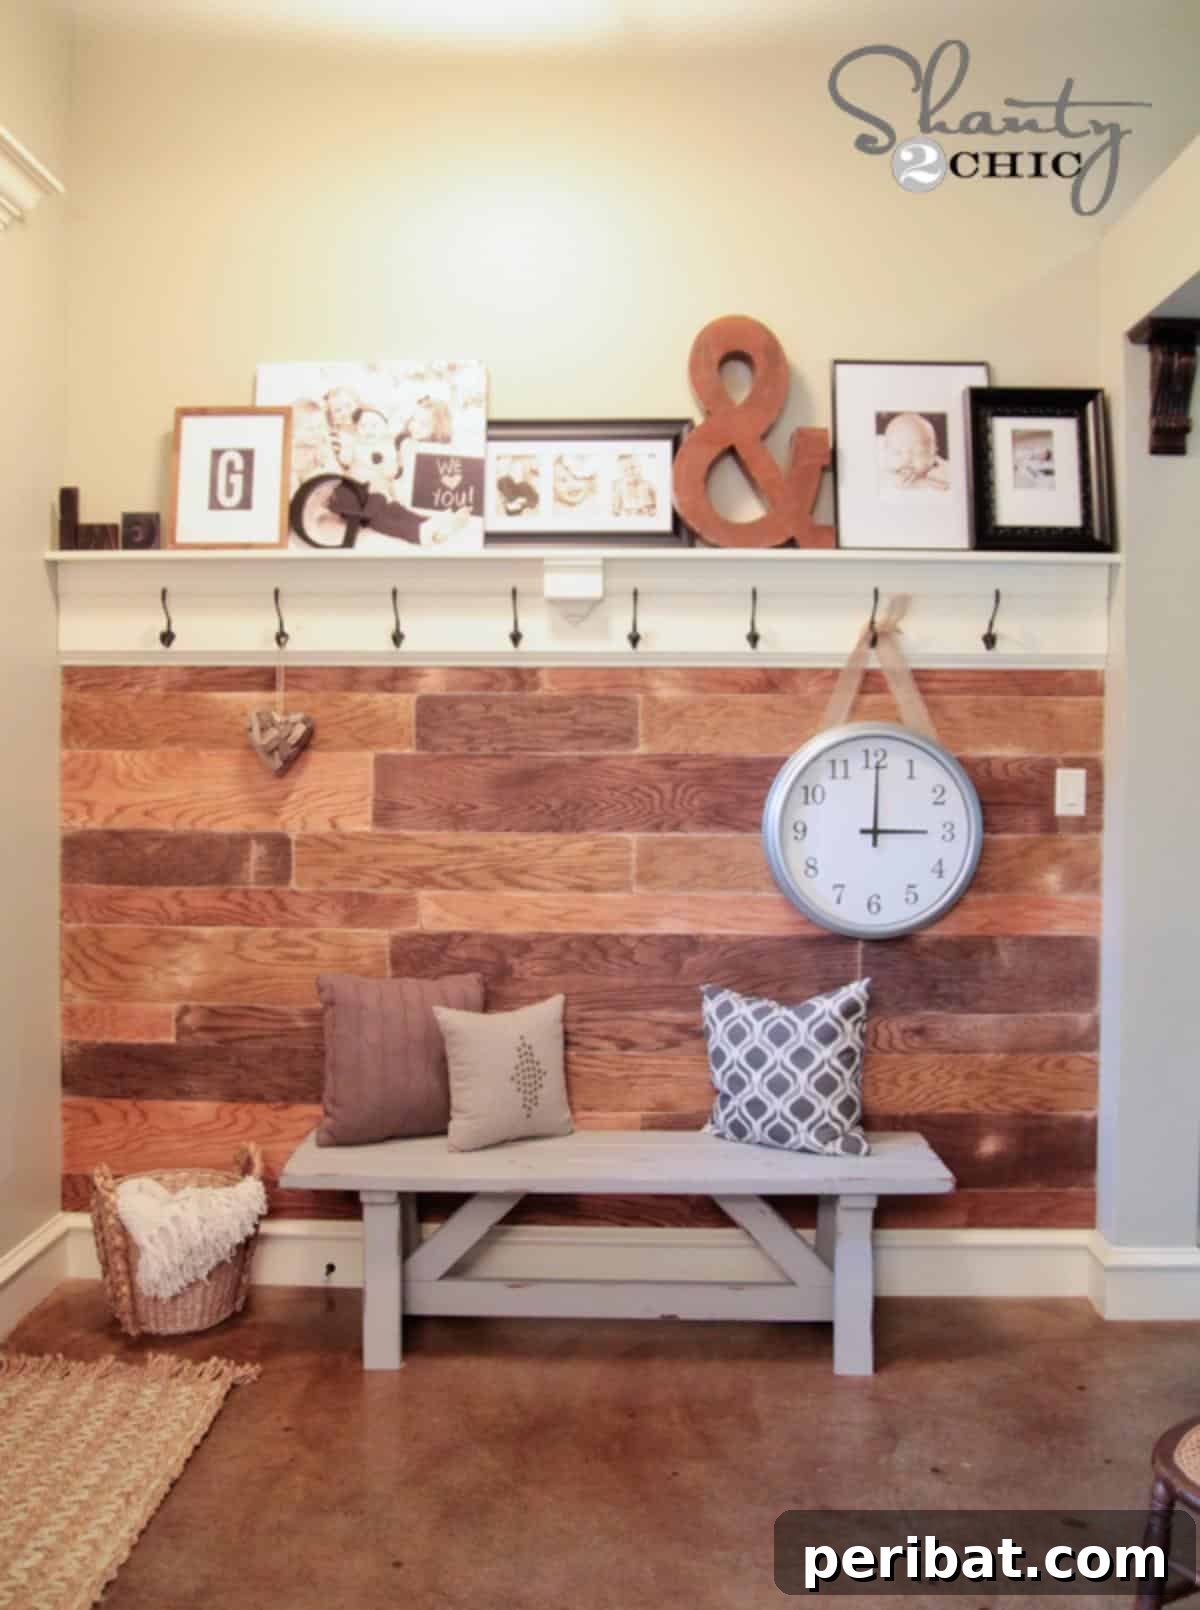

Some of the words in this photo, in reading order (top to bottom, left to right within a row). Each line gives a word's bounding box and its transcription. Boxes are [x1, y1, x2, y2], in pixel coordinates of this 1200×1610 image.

[218, 451, 244, 507] G
[828, 759, 849, 780] 11
[863, 749, 888, 769] 12
[906, 759, 917, 780] 1
[801, 784, 826, 806] 10
[931, 784, 946, 806] 2
[792, 820, 807, 841] 9
[941, 821, 955, 842] 3
[803, 857, 819, 878] 8
[930, 858, 944, 879] 4
[832, 884, 846, 905] 7
[866, 894, 881, 915] 6
[904, 884, 919, 905] 5
